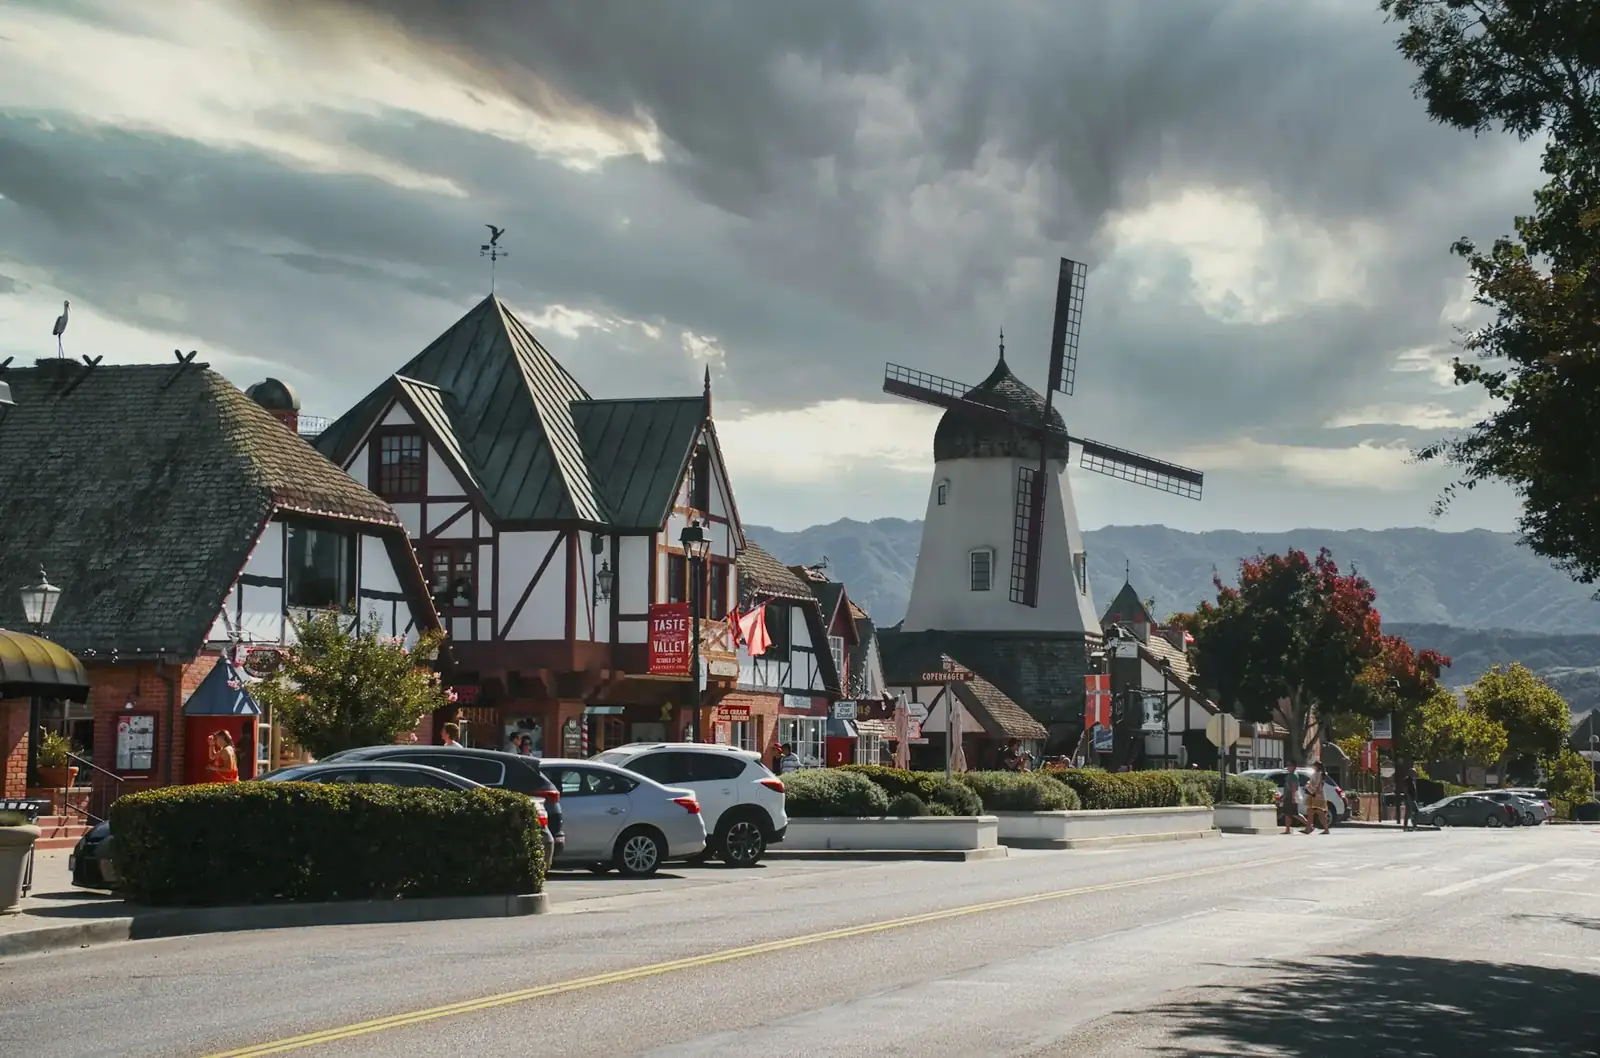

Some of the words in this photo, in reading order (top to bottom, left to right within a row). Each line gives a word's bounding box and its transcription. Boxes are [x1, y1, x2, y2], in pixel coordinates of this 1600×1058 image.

[654, 619, 686, 631] TASTE
[653, 640, 685, 652] VALLEY
[922, 672, 965, 681] COPENHAGEN
